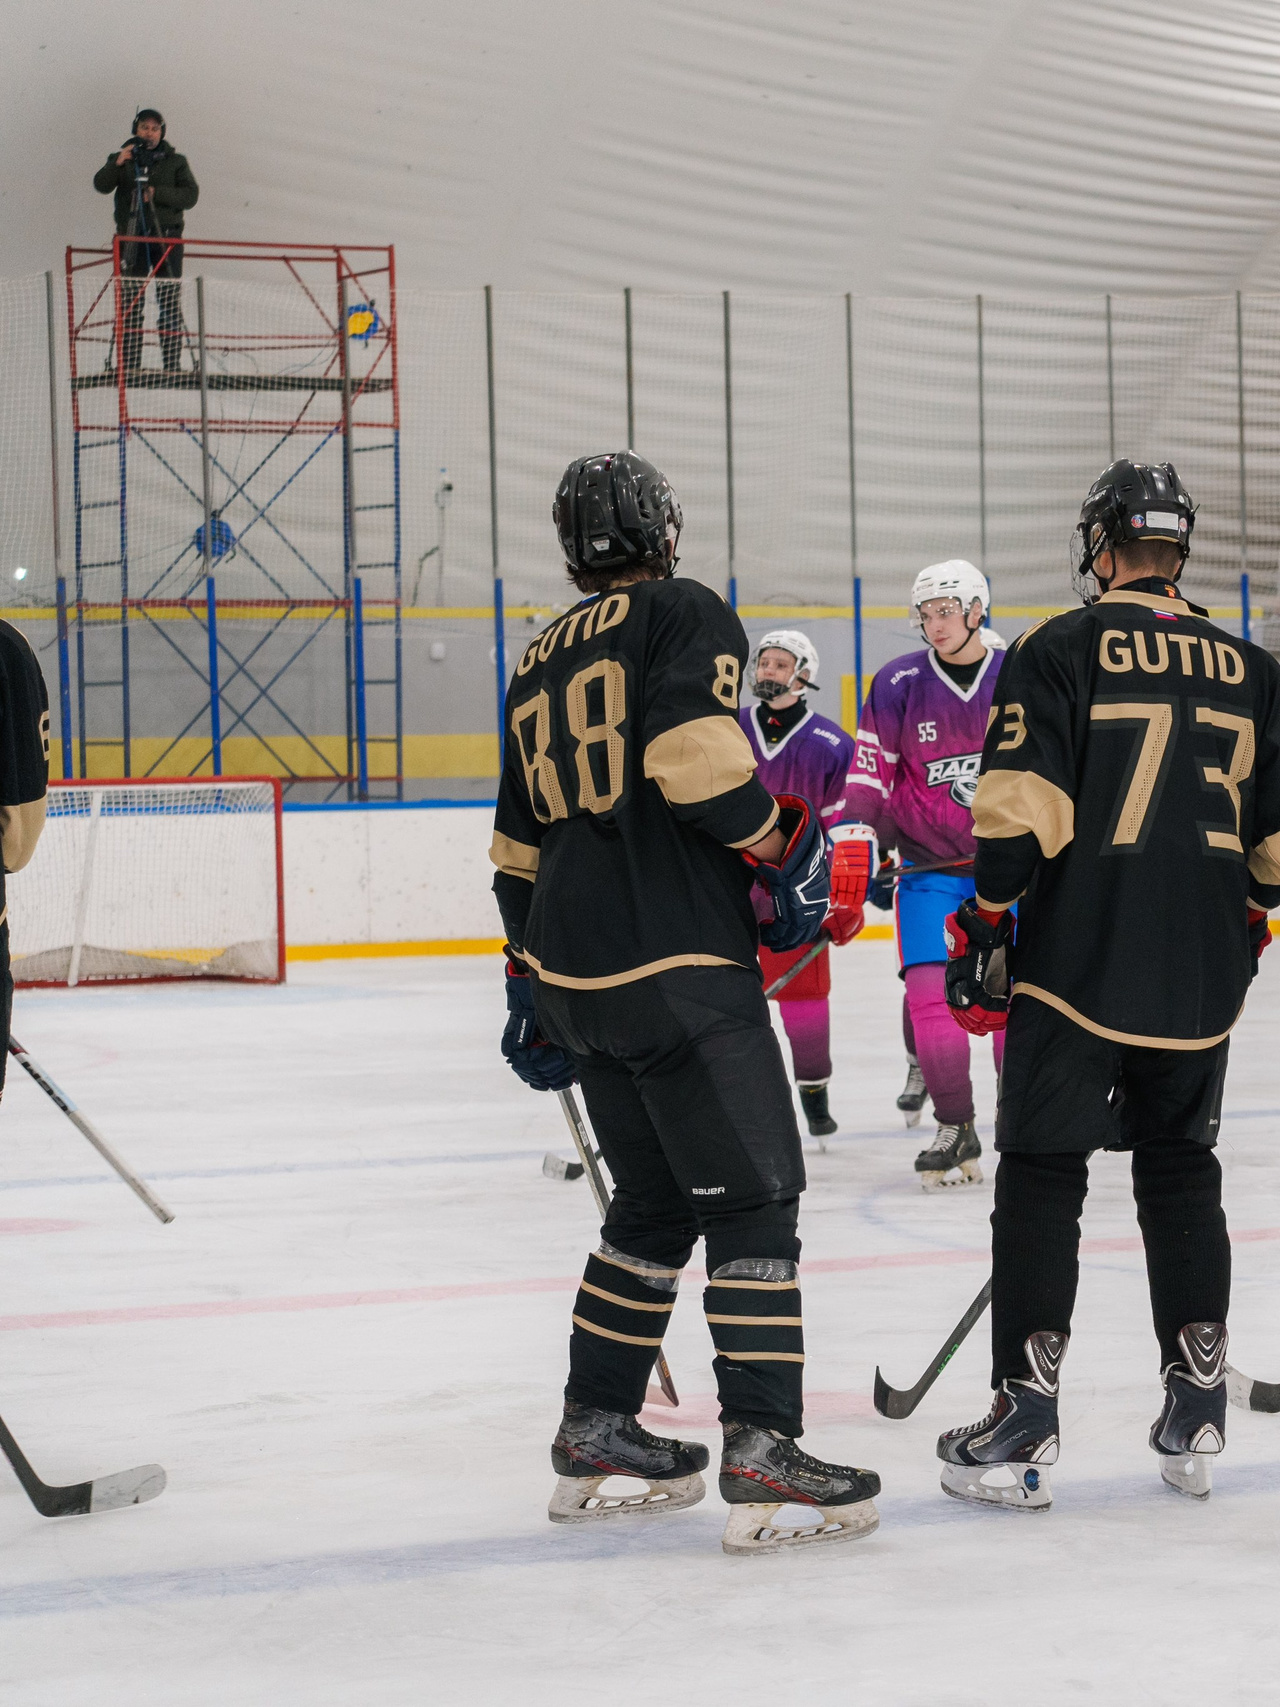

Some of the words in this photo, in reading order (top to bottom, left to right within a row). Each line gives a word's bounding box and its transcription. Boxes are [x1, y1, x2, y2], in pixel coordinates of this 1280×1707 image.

[516, 593, 630, 677] GUTID
[1099, 629, 1245, 685] GUTID
[712, 654, 739, 709] 8
[918, 721, 937, 743] 55
[856, 744, 877, 773] 55
[926, 753, 982, 785] RAQ
[1090, 702, 1256, 854] 73
[692, 1186, 725, 1195] BAUER
[1033, 1343, 1048, 1371] VAPOR
